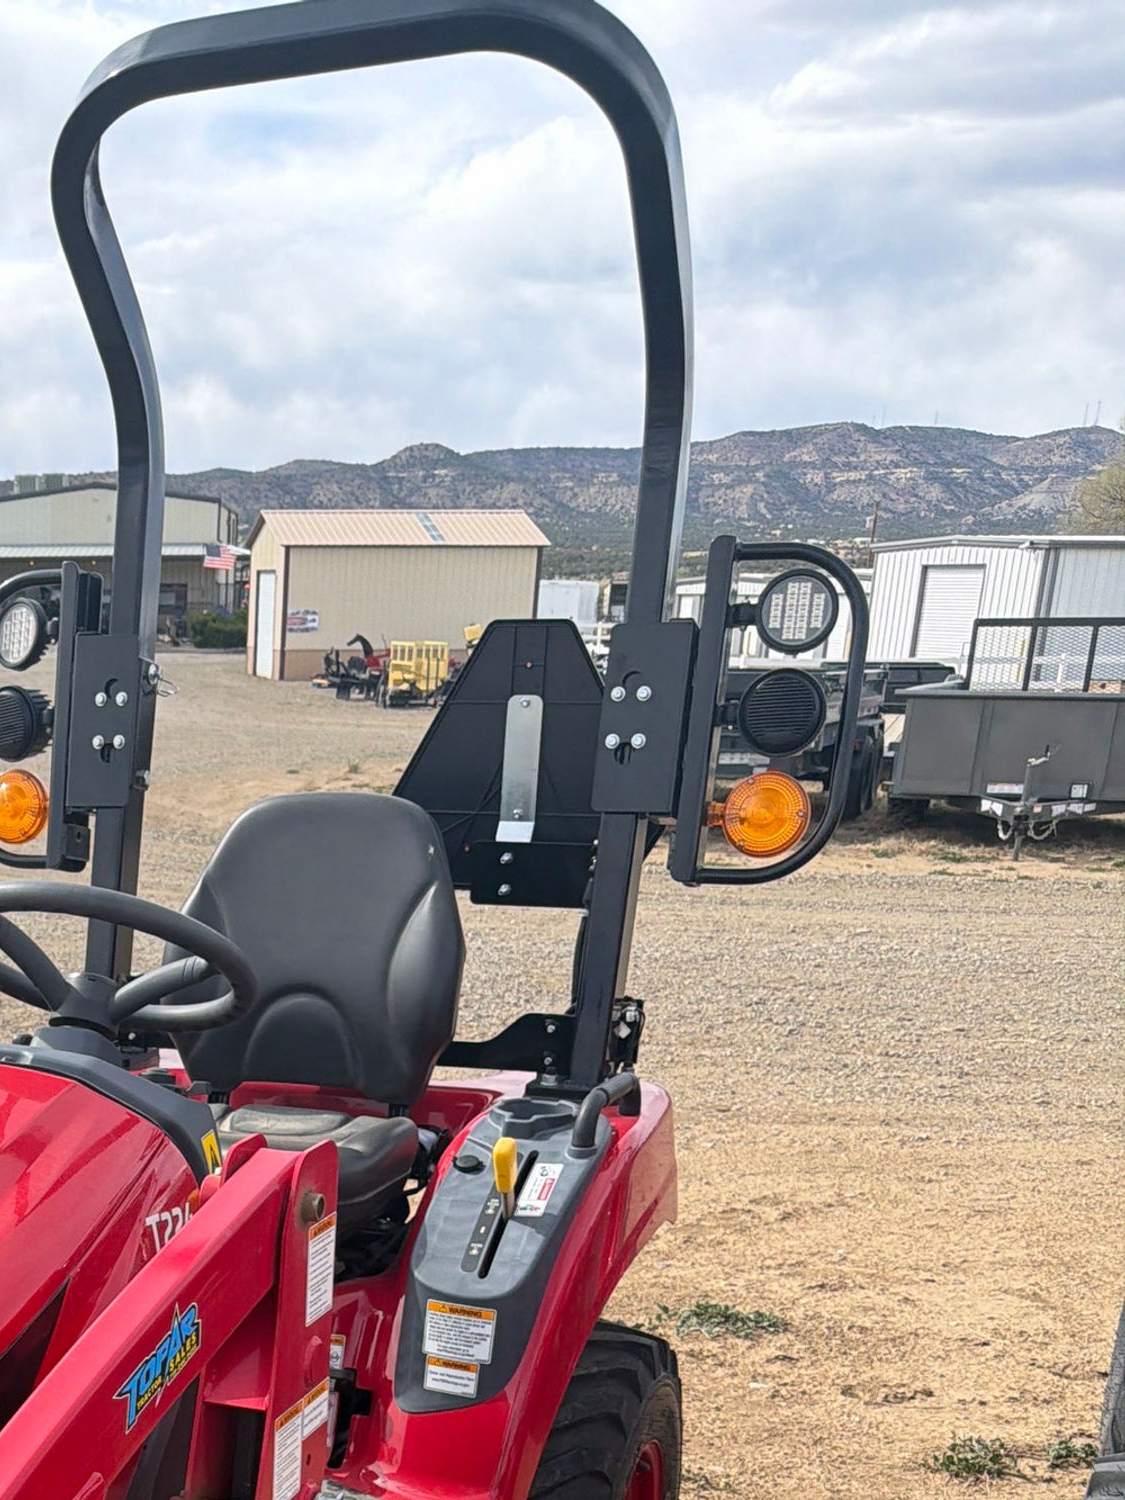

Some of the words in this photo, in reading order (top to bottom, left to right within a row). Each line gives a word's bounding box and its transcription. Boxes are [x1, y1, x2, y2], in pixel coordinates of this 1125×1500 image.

[448, 1306, 482, 1318] WARNING
[120, 1307, 198, 1427] TOPAR
[169, 1333, 197, 1373] SALES
[137, 1375, 162, 1410] TRACTOR
